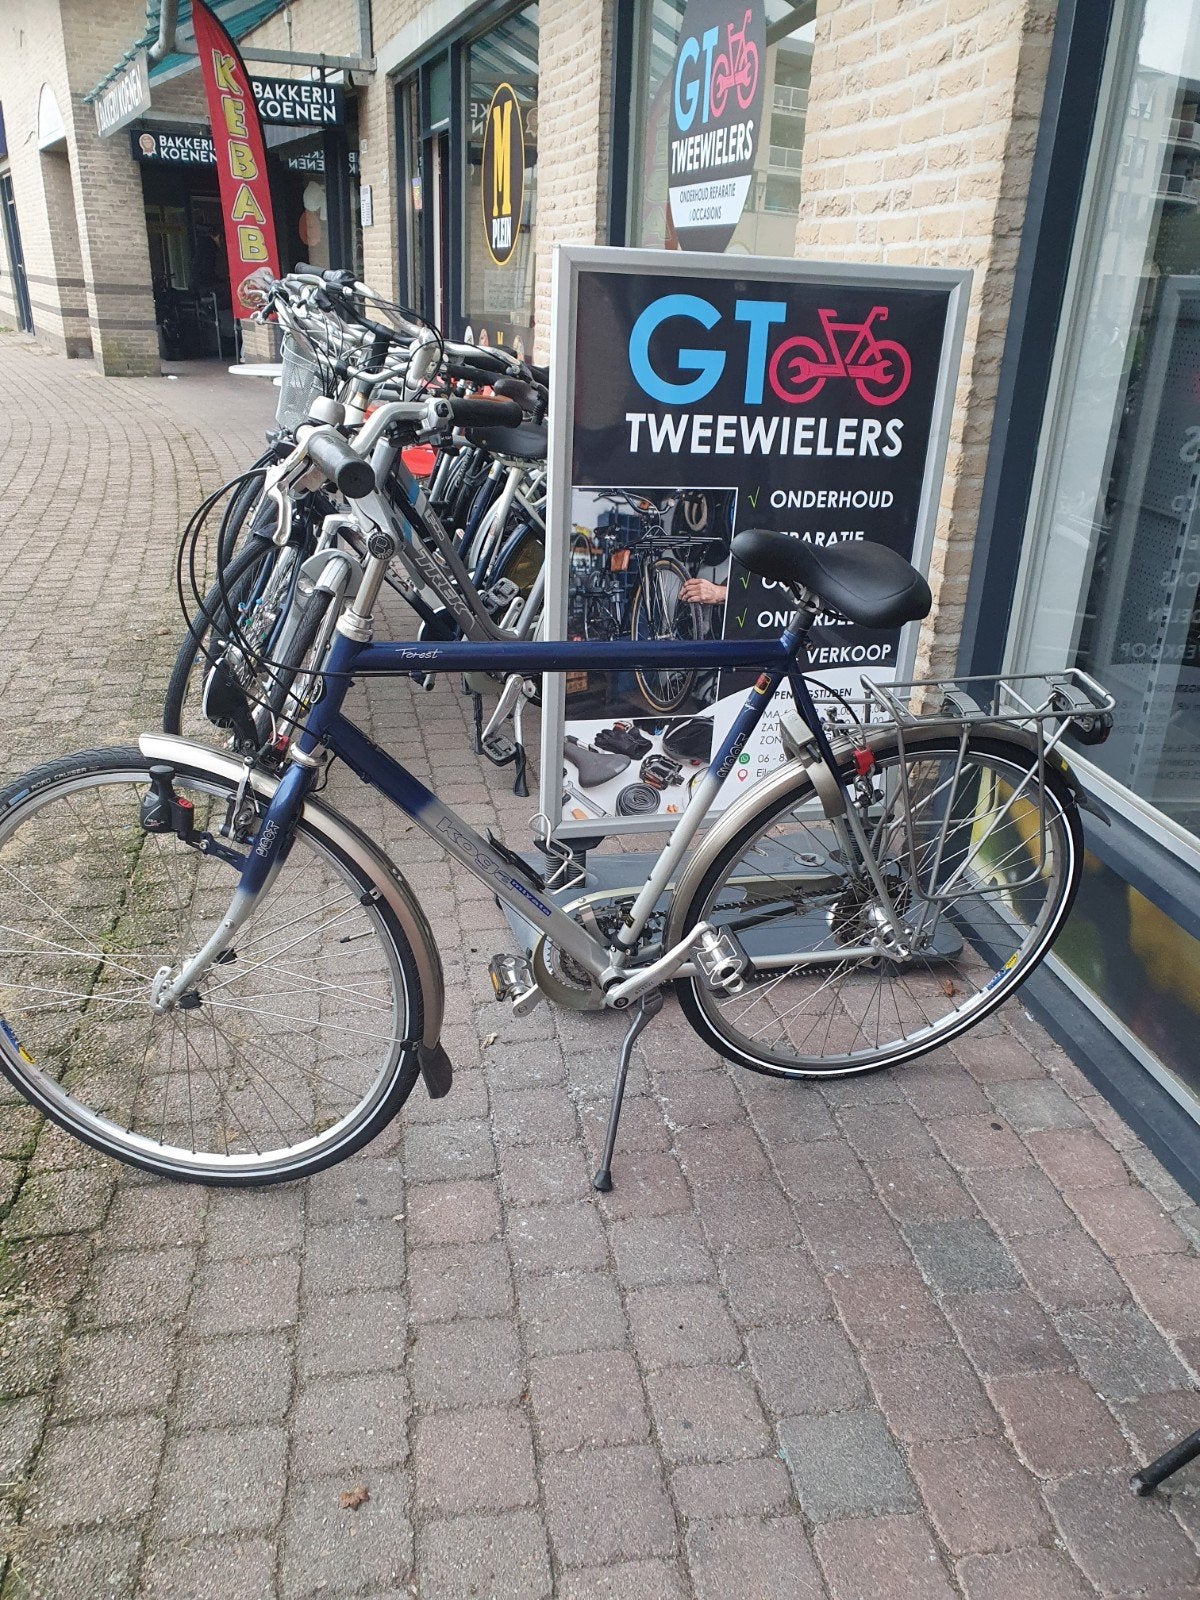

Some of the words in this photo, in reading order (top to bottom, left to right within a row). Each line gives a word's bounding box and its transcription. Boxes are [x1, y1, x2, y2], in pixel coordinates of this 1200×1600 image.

[251, 81, 336, 105] BAKKERIJ
[674, 25, 720, 132] GT
[258, 99, 338, 122] KOENEN
[158, 134, 216, 151] BAKKERI
[160, 147, 218, 163] KOENEN
[211, 48, 269, 263] KEBAB
[671, 119, 755, 175] TWEEWIELERS
[492, 99, 513, 218] M
[679, 187, 709, 203] ONDERHOUD
[709, 183, 737, 199] REPARATIE
[691, 206, 722, 222] OCCASIONS
[492, 216, 512, 250] PLEIN
[628, 293, 788, 406] GT
[625, 412, 905, 458] TWEEWIELERS
[769, 489, 895, 509] ONDERHOUD
[414, 547, 469, 615] TREK
[394, 647, 444, 660] Forest
[806, 643, 892, 664] VERKOOP
[436, 816, 516, 891] koga
